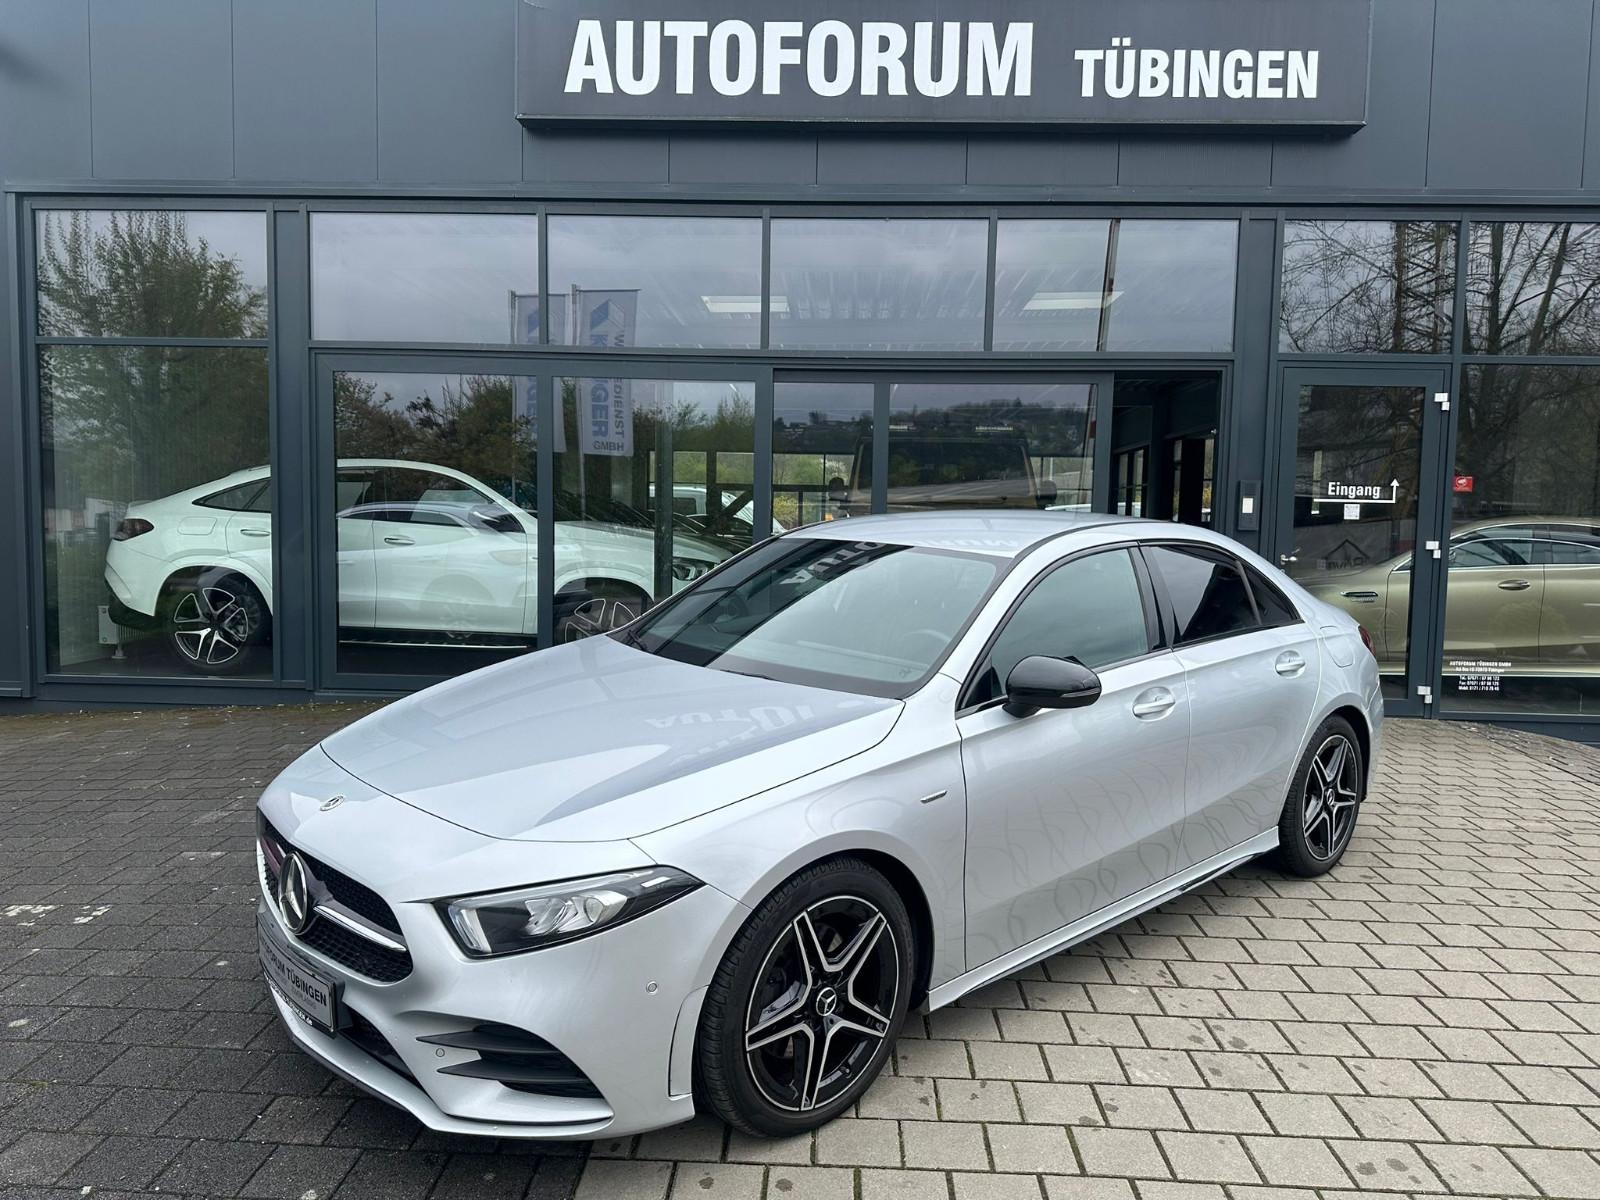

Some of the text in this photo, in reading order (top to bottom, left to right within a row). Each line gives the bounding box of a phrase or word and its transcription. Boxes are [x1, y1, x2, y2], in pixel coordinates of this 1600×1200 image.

[564, 20, 1319, 99] AUTOFORUM TÜBINGEN
[1328, 482, 1381, 499] Eingang
[286, 967, 327, 1006] TÜBINGEN
